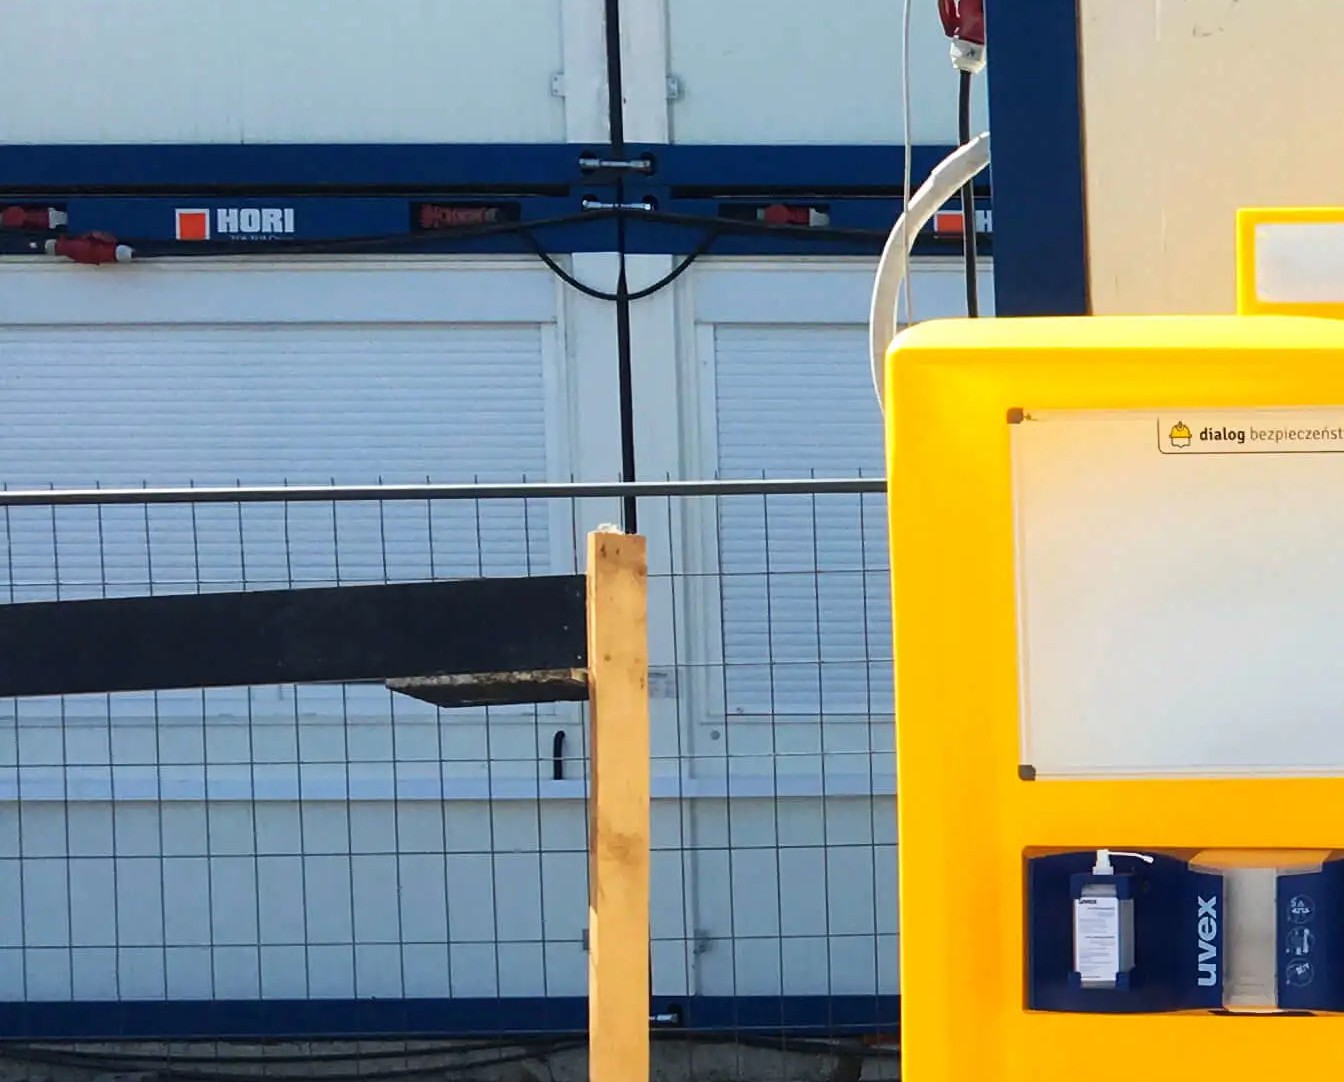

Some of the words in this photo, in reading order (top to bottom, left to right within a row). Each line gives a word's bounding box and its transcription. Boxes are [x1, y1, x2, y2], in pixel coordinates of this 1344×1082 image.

[217, 208, 294, 233] HORI
[1200, 427, 1245, 443] dialog
[1198, 896, 1217, 986] uvex
